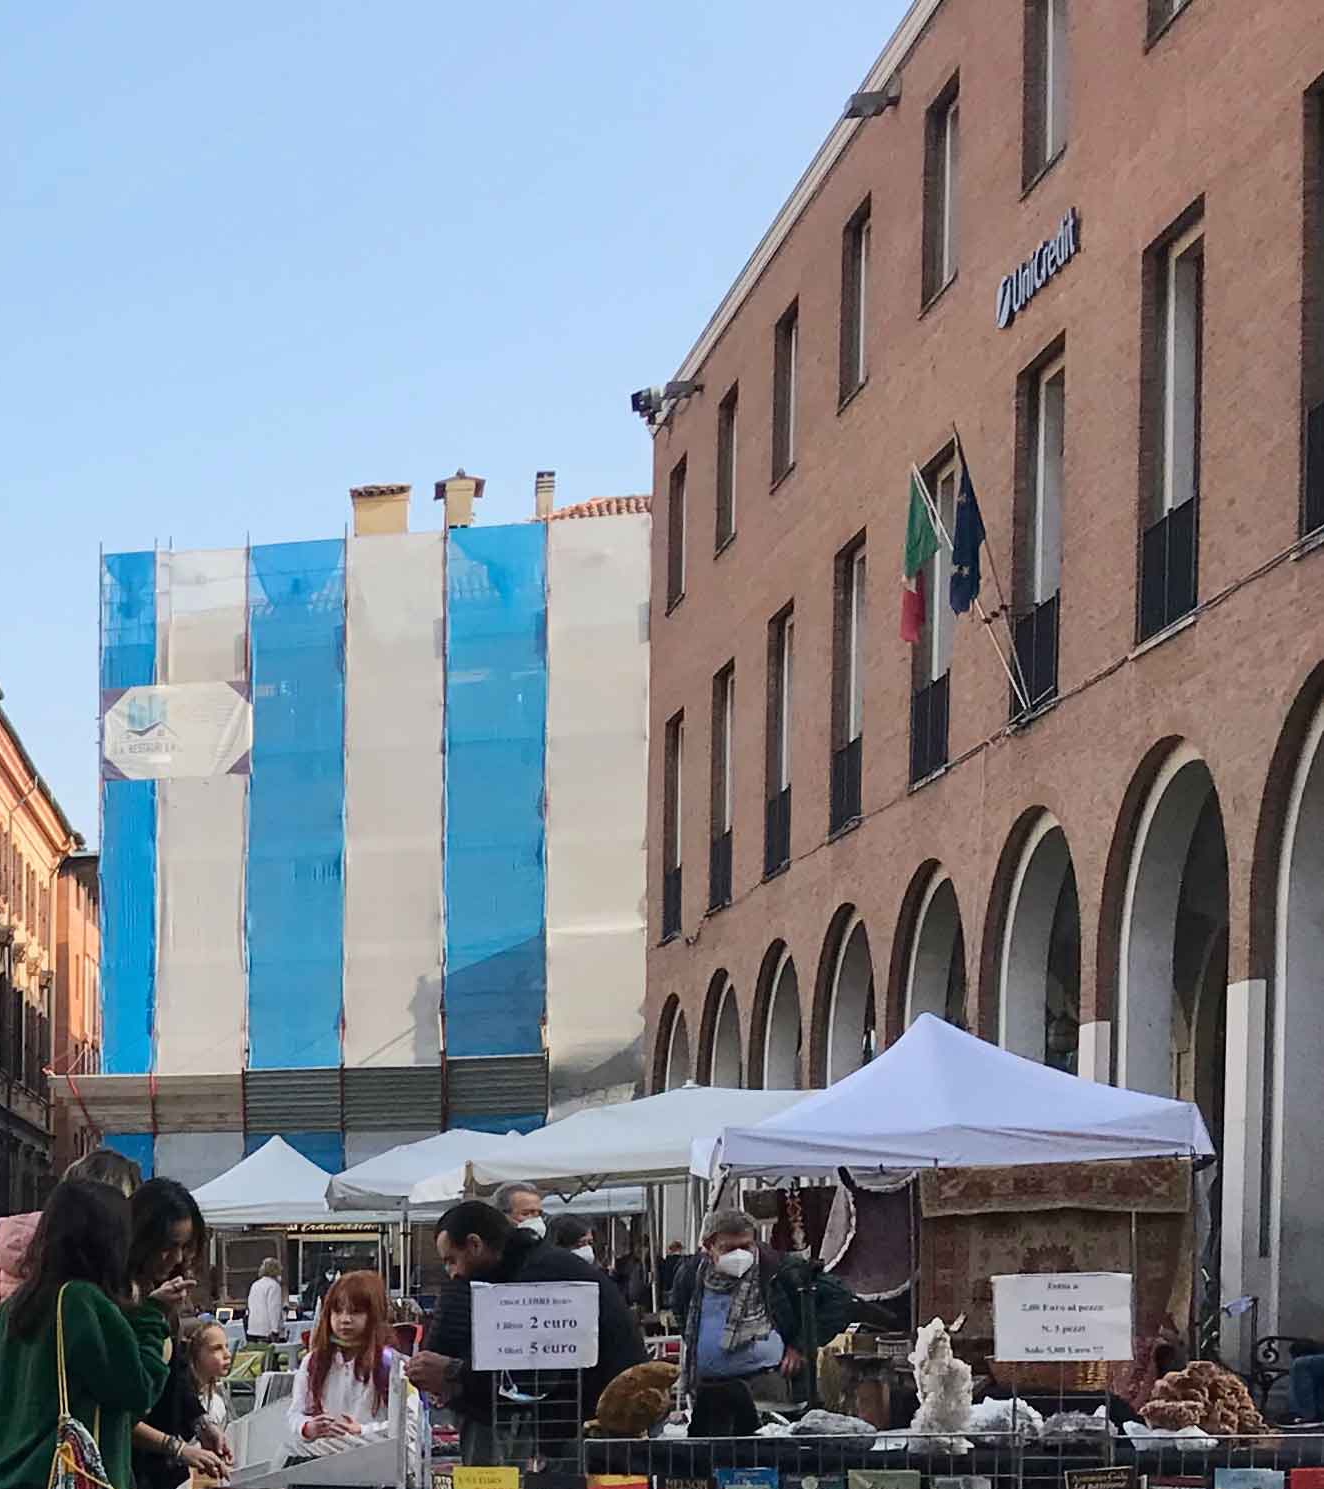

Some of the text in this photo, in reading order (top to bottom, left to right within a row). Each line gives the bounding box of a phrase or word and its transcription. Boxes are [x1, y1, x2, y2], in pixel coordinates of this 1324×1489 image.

[1011, 207, 1077, 312] UniCredit
[529, 1316, 539, 1329] 2
[543, 1319, 578, 1329] euro
[529, 1341, 539, 1354] 5
[542, 1343, 578, 1354] euro
